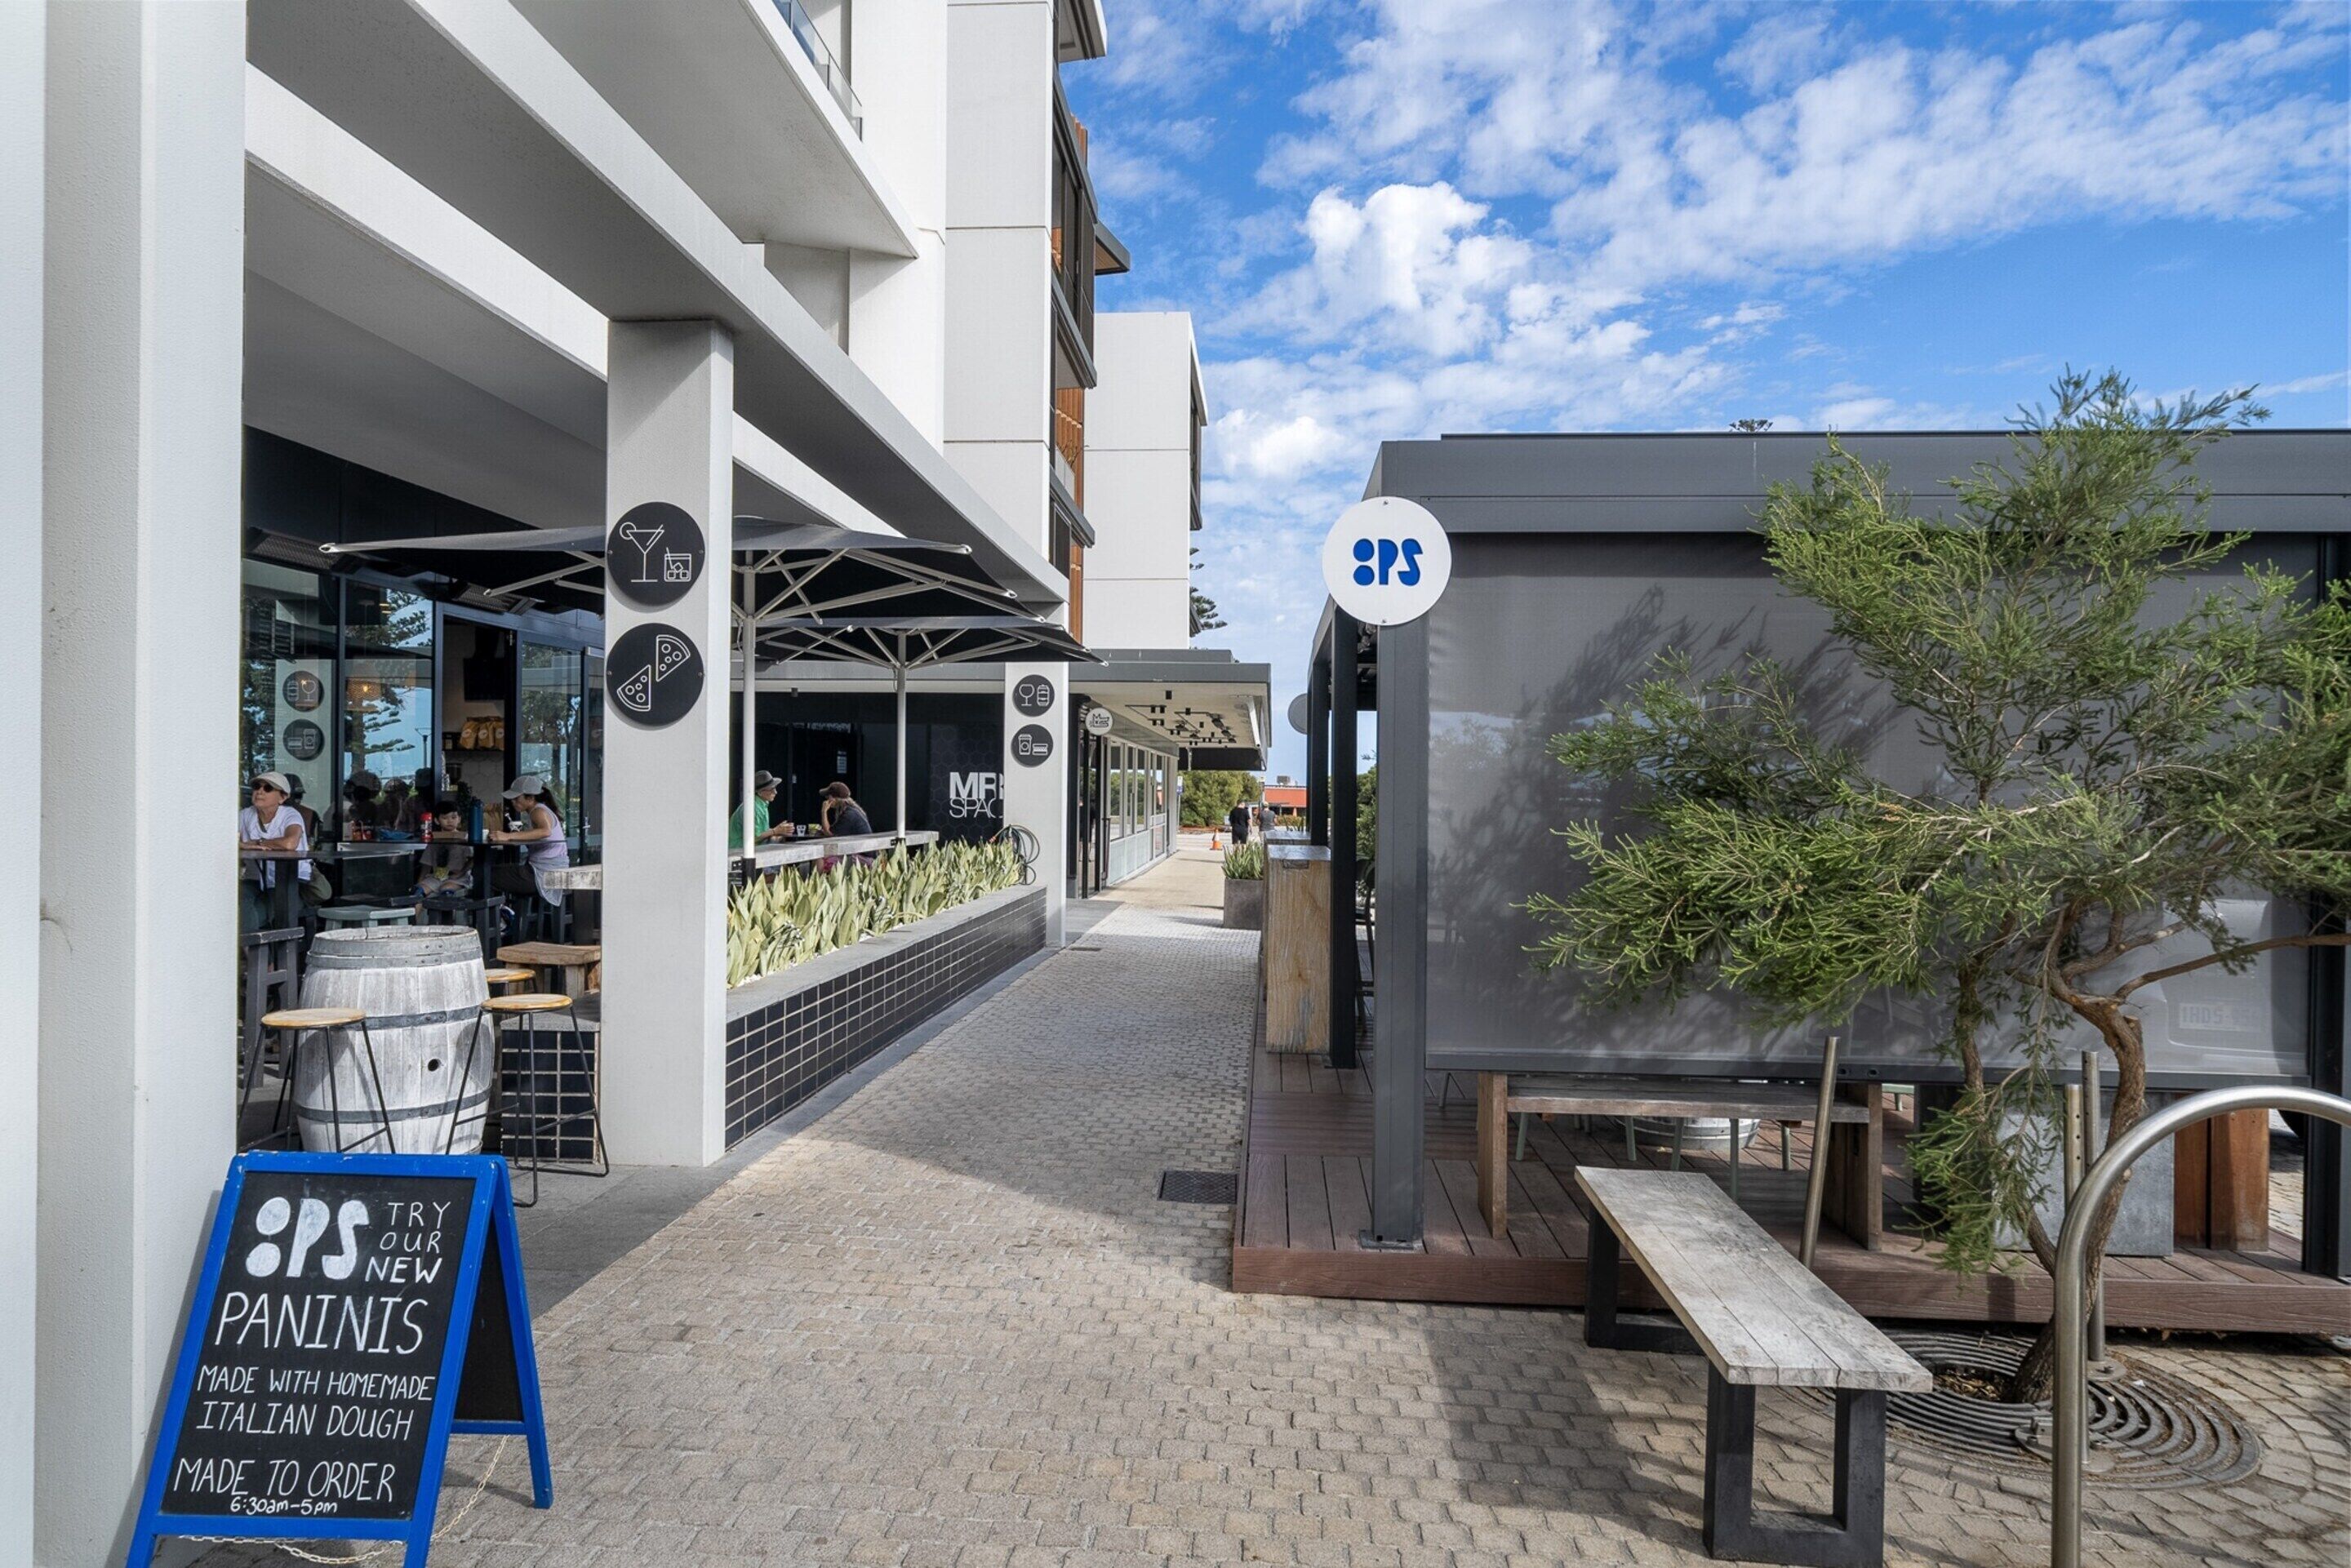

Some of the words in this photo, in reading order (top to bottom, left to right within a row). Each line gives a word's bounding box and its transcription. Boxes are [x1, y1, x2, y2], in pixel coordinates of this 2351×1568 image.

[387, 1202, 451, 1228] TRY
[380, 1231, 442, 1254] OUR
[365, 1256, 442, 1284] NEW
[214, 1291, 428, 1354] PANINIS
[197, 1365, 259, 1393] MADE
[269, 1369, 321, 1395] WITH
[327, 1372, 435, 1401] HOMEMADE
[196, 1401, 317, 1436] ITALIAN
[327, 1406, 414, 1441] DOUGH
[173, 1458, 255, 1495] MADE
[267, 1460, 299, 1496] TO
[307, 1460, 396, 1502] ORDER
